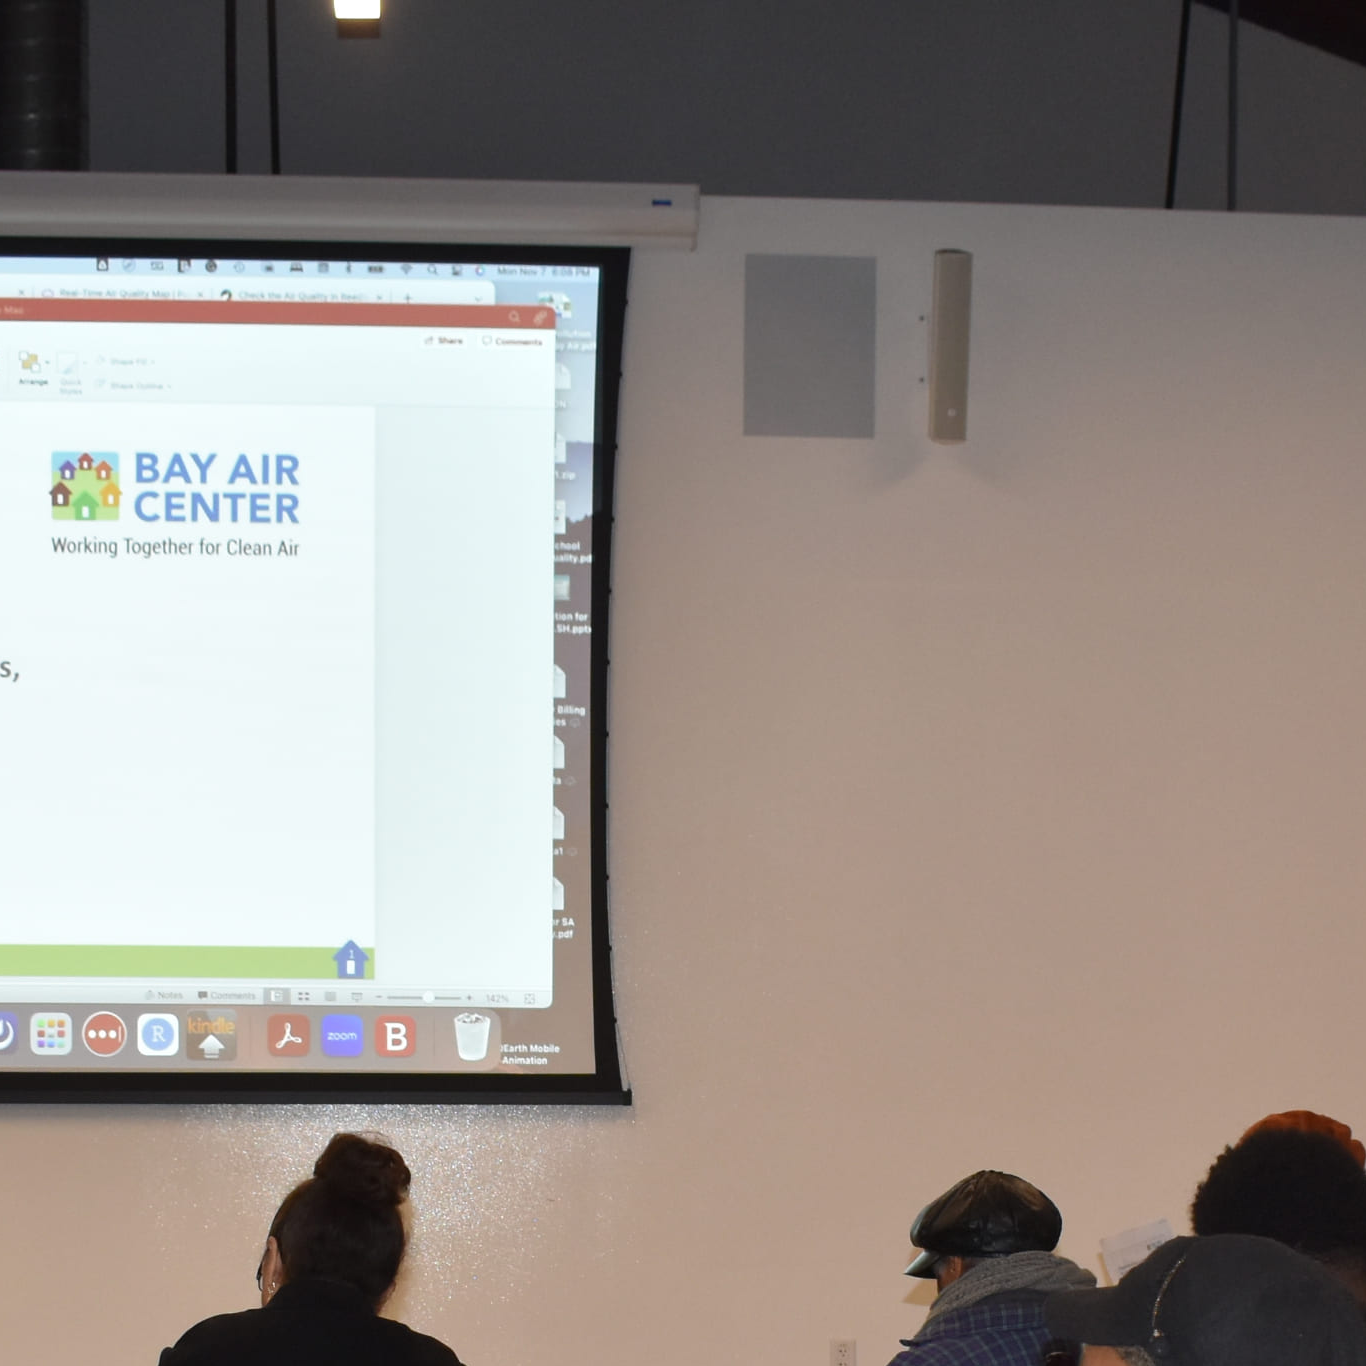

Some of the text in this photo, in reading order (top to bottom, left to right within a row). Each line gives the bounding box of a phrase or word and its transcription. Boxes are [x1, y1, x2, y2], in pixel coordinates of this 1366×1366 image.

[498, 266, 517, 276] Mon
[520, 267, 538, 277] Nov
[135, 452, 299, 486] BAY AIR
[134, 492, 300, 525] CENTER
[51, 537, 300, 561] Working Together for Clean Air
[557, 705, 586, 717] Billing
[157, 991, 183, 1001] Notes
[210, 991, 256, 1001] Comments
[188, 1016, 236, 1035] kindle
[326, 1030, 359, 1041] zoom
[385, 1022, 409, 1052] B
[530, 1043, 561, 1055] Mobile
[502, 1055, 548, 1066] Animation
